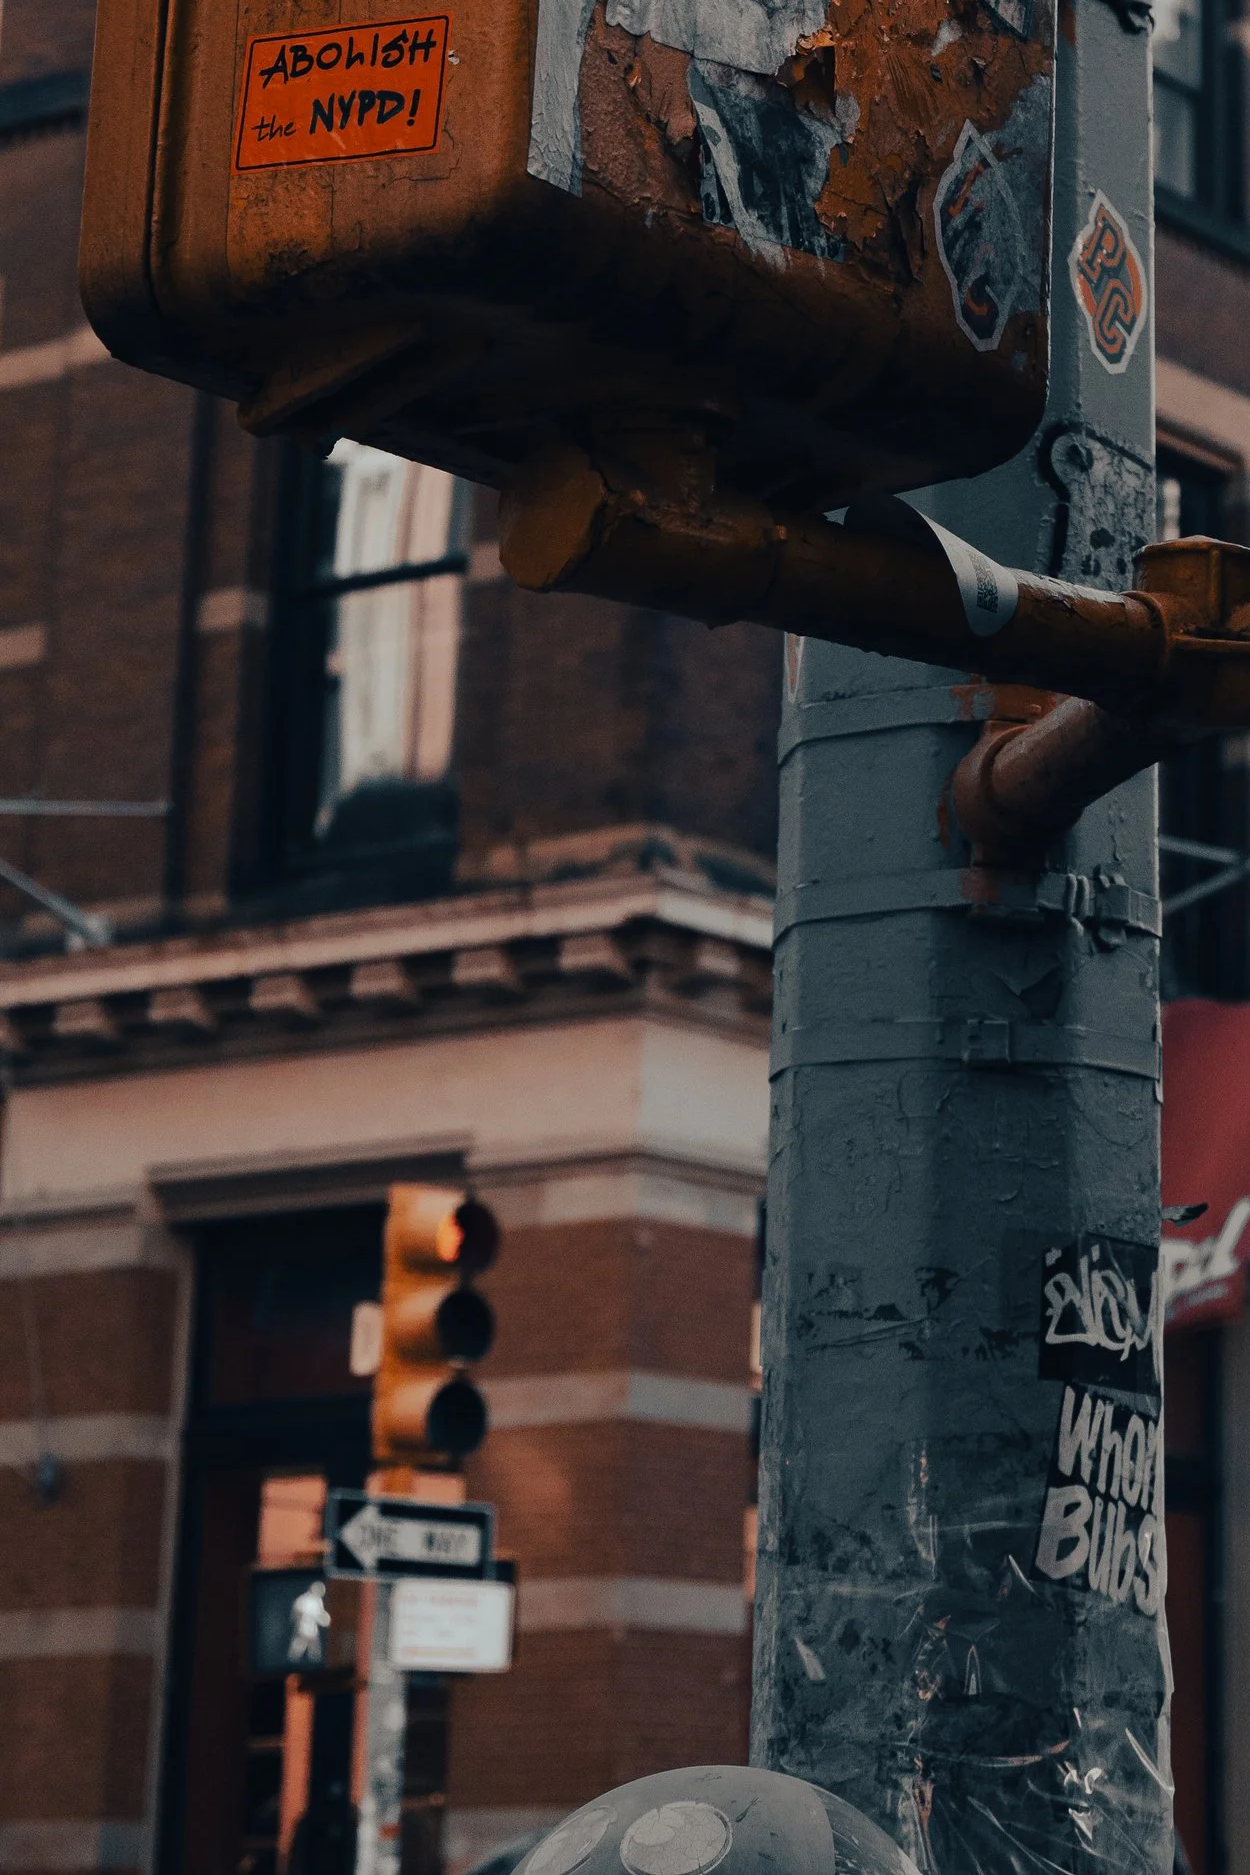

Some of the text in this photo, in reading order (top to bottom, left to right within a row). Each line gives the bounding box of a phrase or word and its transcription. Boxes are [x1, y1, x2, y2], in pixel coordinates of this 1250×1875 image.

[258, 28, 437, 90] ABOLISH
[251, 88, 421, 142] the NYPD!
